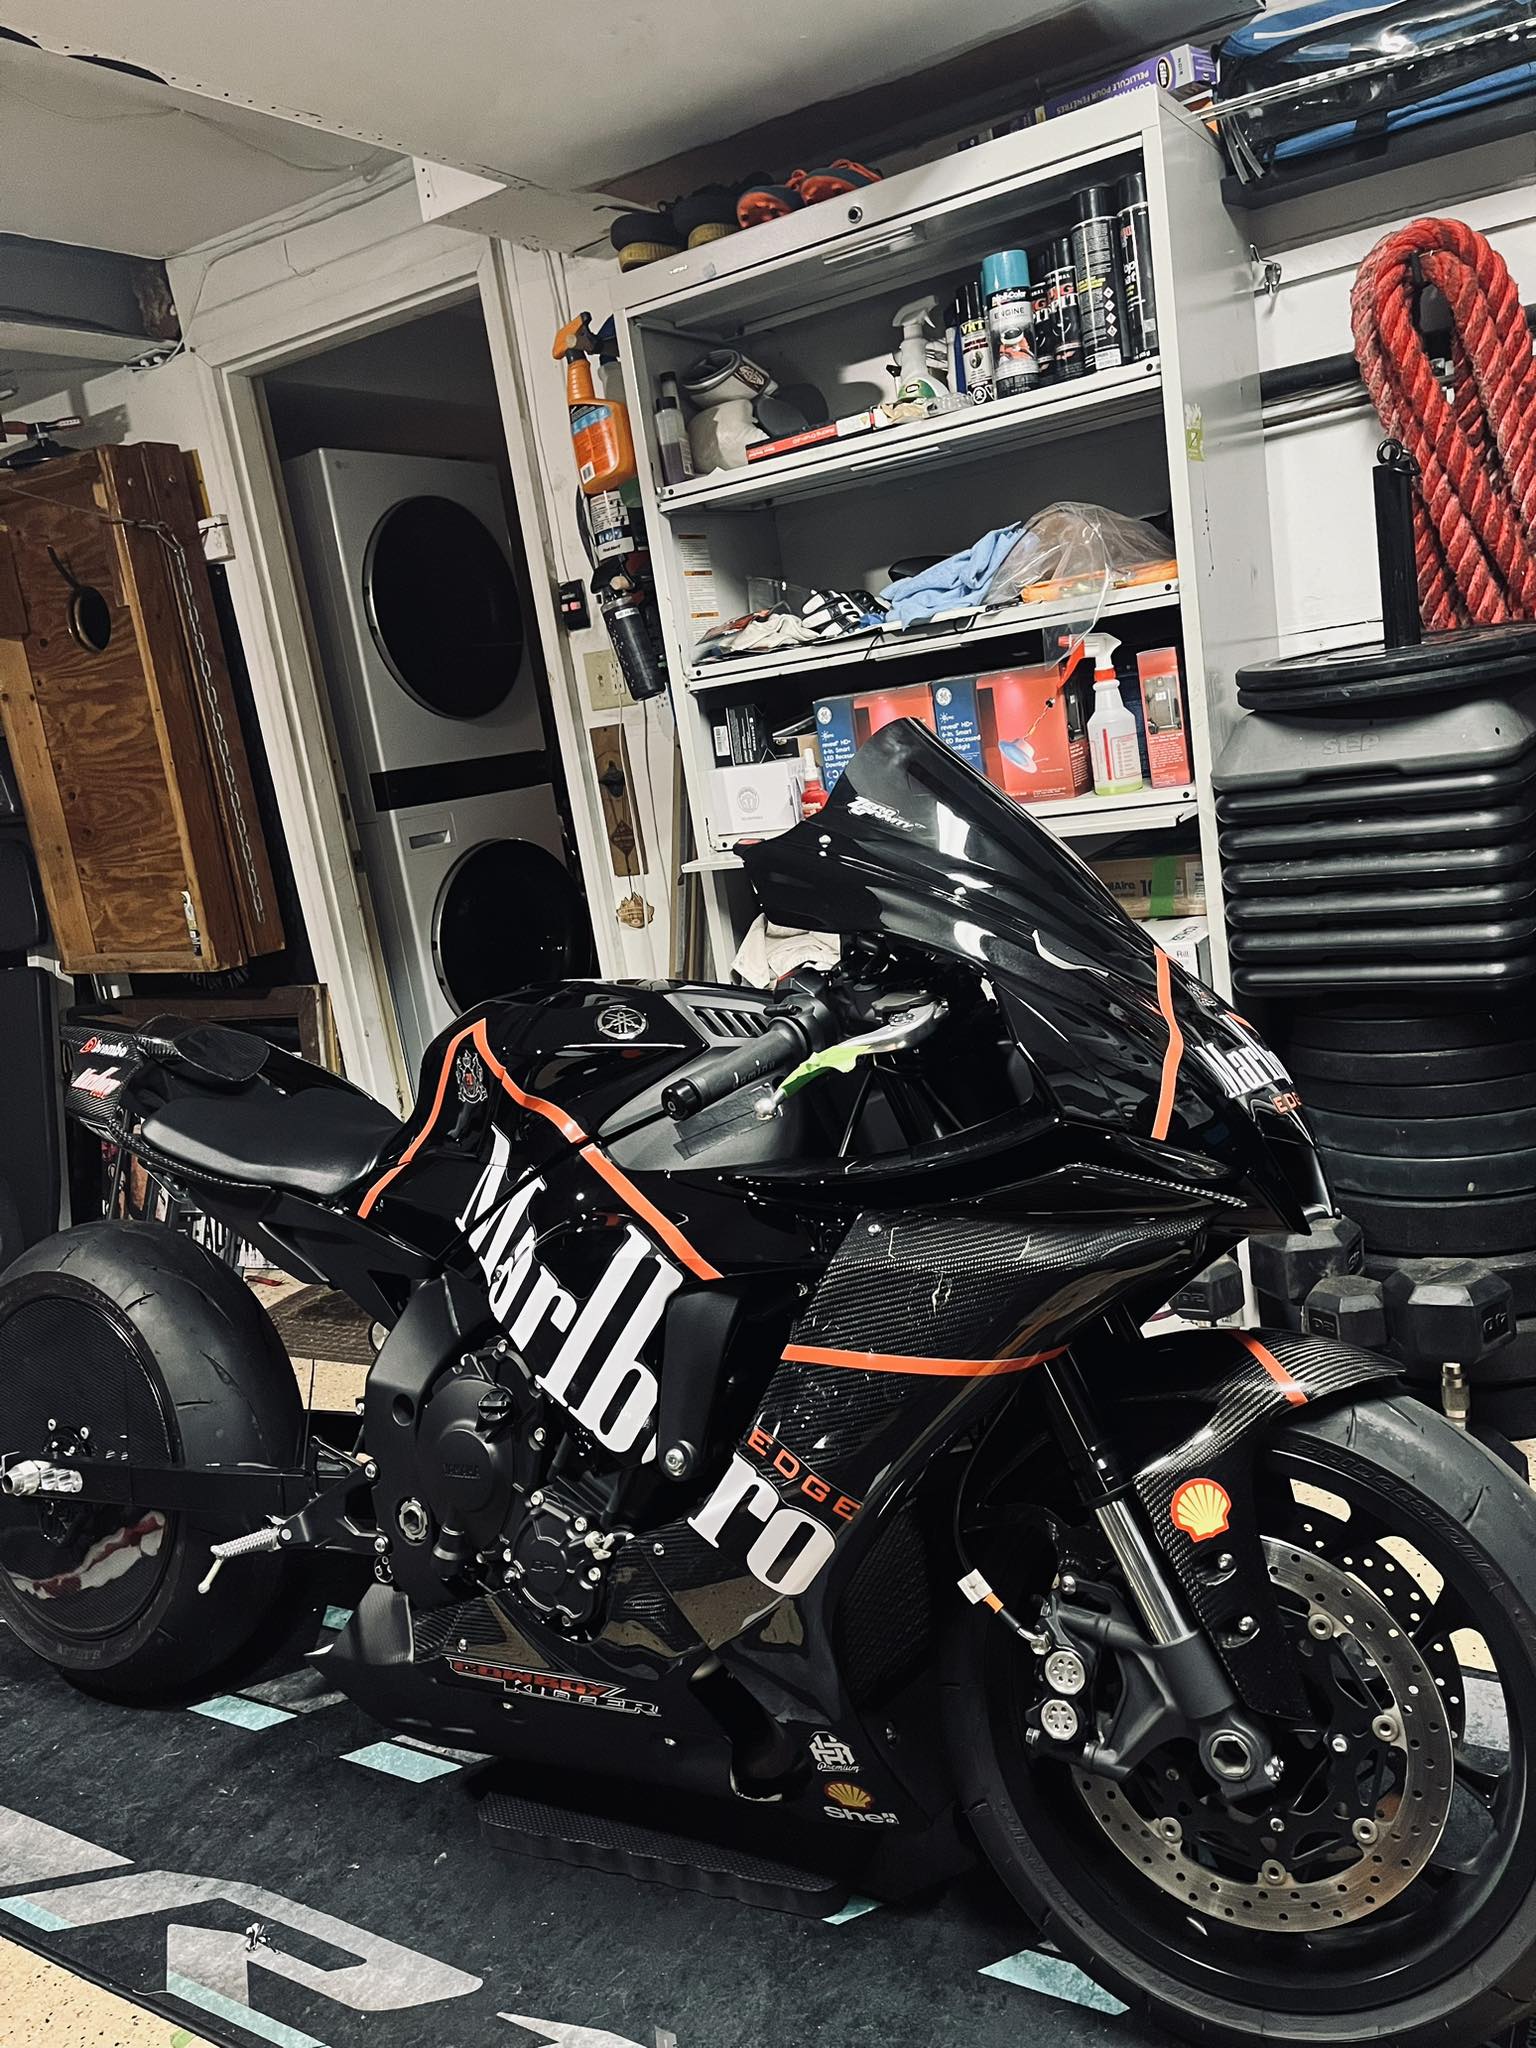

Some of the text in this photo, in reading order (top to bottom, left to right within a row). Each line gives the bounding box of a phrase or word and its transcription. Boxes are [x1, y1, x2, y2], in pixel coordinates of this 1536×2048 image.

[994, 307, 1025, 320] ENGINE
[747, 1427, 861, 1522] EDGE
[453, 1660, 610, 1697] COWBOY
[817, 1761, 860, 1774] Premium
[824, 1805, 900, 1825] Shell
